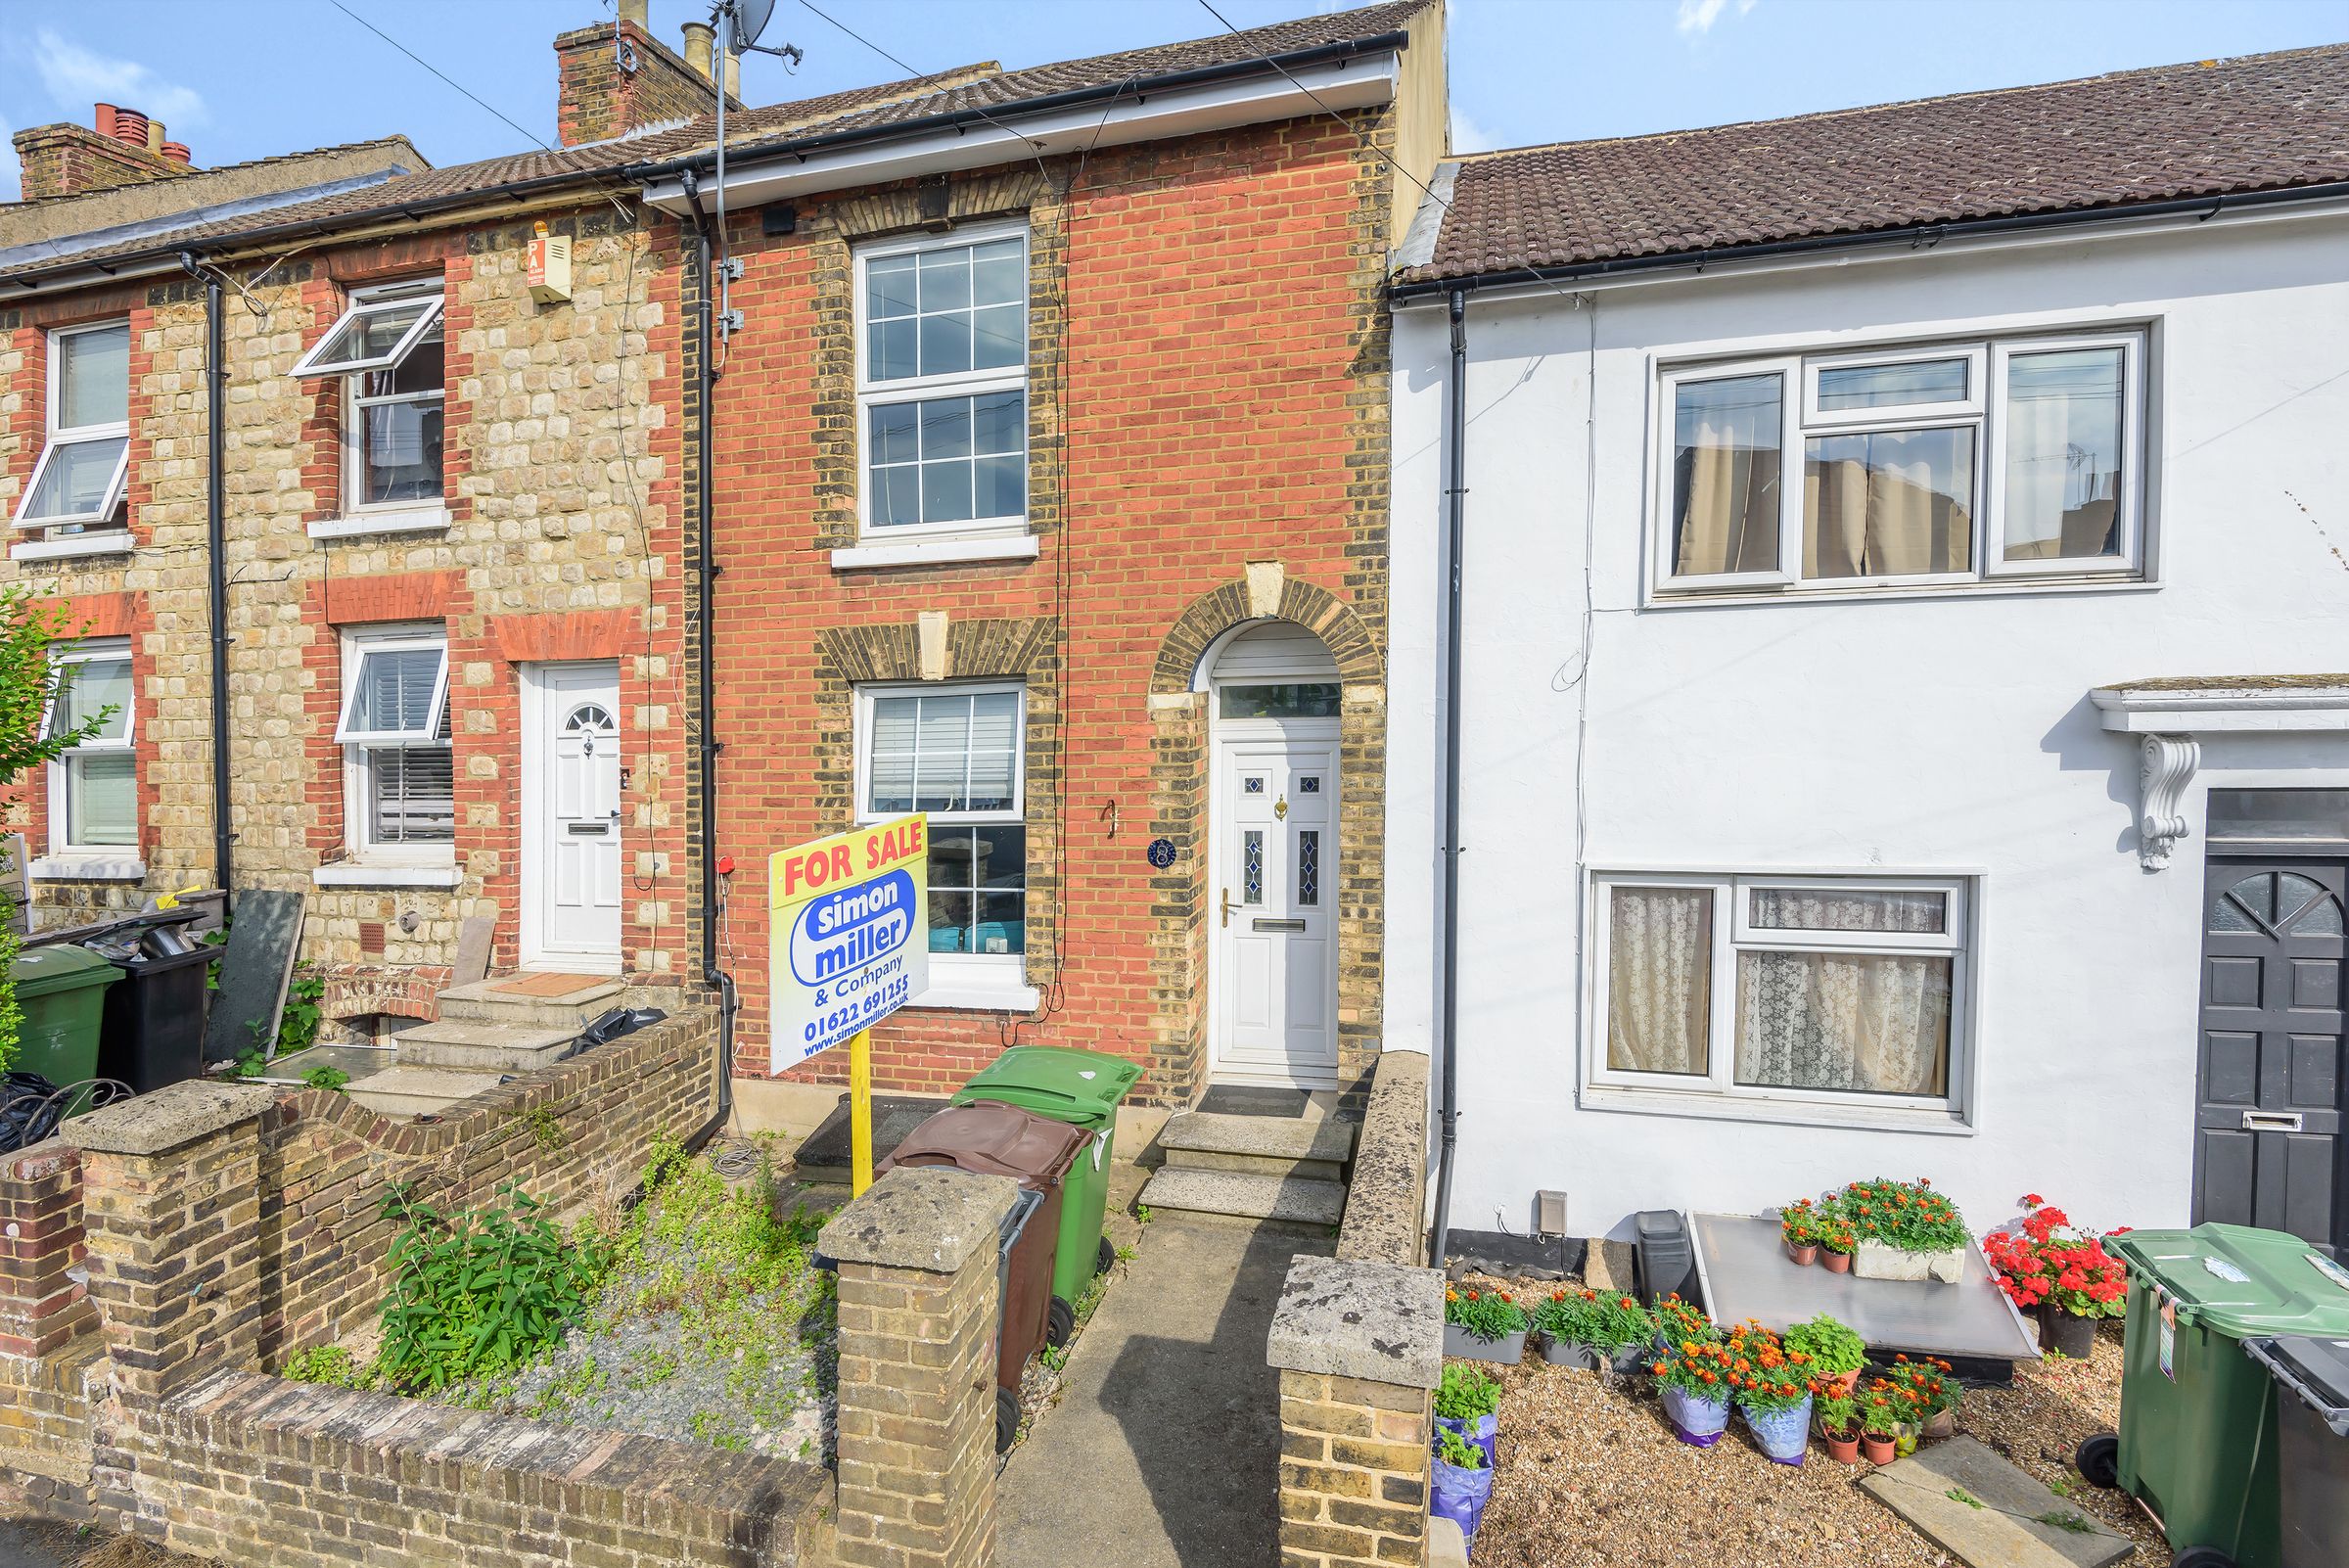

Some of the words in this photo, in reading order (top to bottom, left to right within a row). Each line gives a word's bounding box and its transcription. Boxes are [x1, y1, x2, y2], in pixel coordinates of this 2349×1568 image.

[785, 844, 853, 896] FOR
[866, 821, 922, 870] SALE
[1157, 846, 1169, 864] 8
[815, 916, 900, 979] miller
[805, 1002, 859, 1041] 01622
[863, 974, 908, 1013] 691255
[814, 989, 829, 1007] &
[835, 955, 903, 997] Company
[805, 992, 909, 1057] www.simonmiller.co.uk
